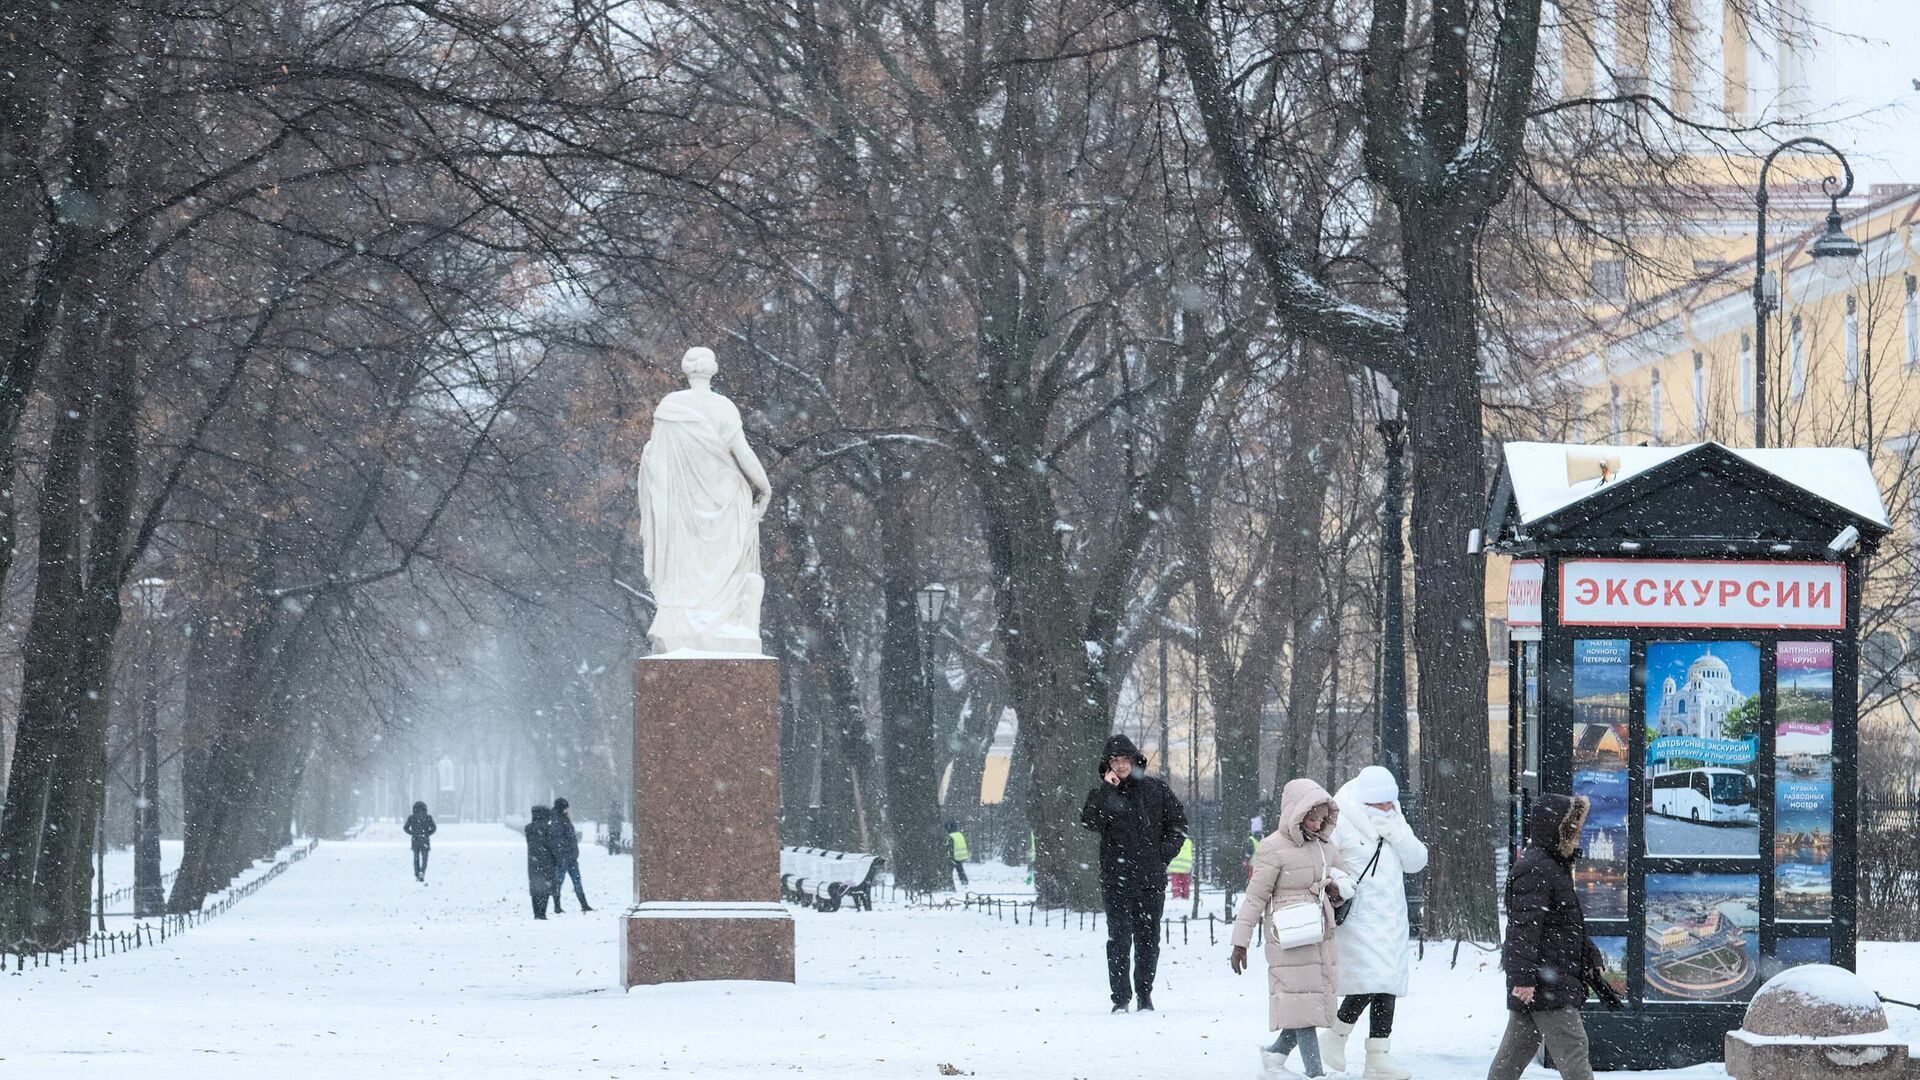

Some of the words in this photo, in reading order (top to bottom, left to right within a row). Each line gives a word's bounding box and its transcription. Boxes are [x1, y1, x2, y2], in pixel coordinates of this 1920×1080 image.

[1574, 578, 1831, 609] ЭКСКУРСИИ
[1779, 646, 1830, 654] БАЛТИЙСКИЙ
[1792, 656, 1817, 664] КРУИЗ
[1656, 739, 1706, 750] АВТОБУСНЫЕ
[1708, 742, 1750, 752] ЭКСКУРСИИ
[1666, 749, 1704, 757] ПЕТЕРБУРГУ
[1710, 753, 1751, 761] ПРИГОРОДАМ
